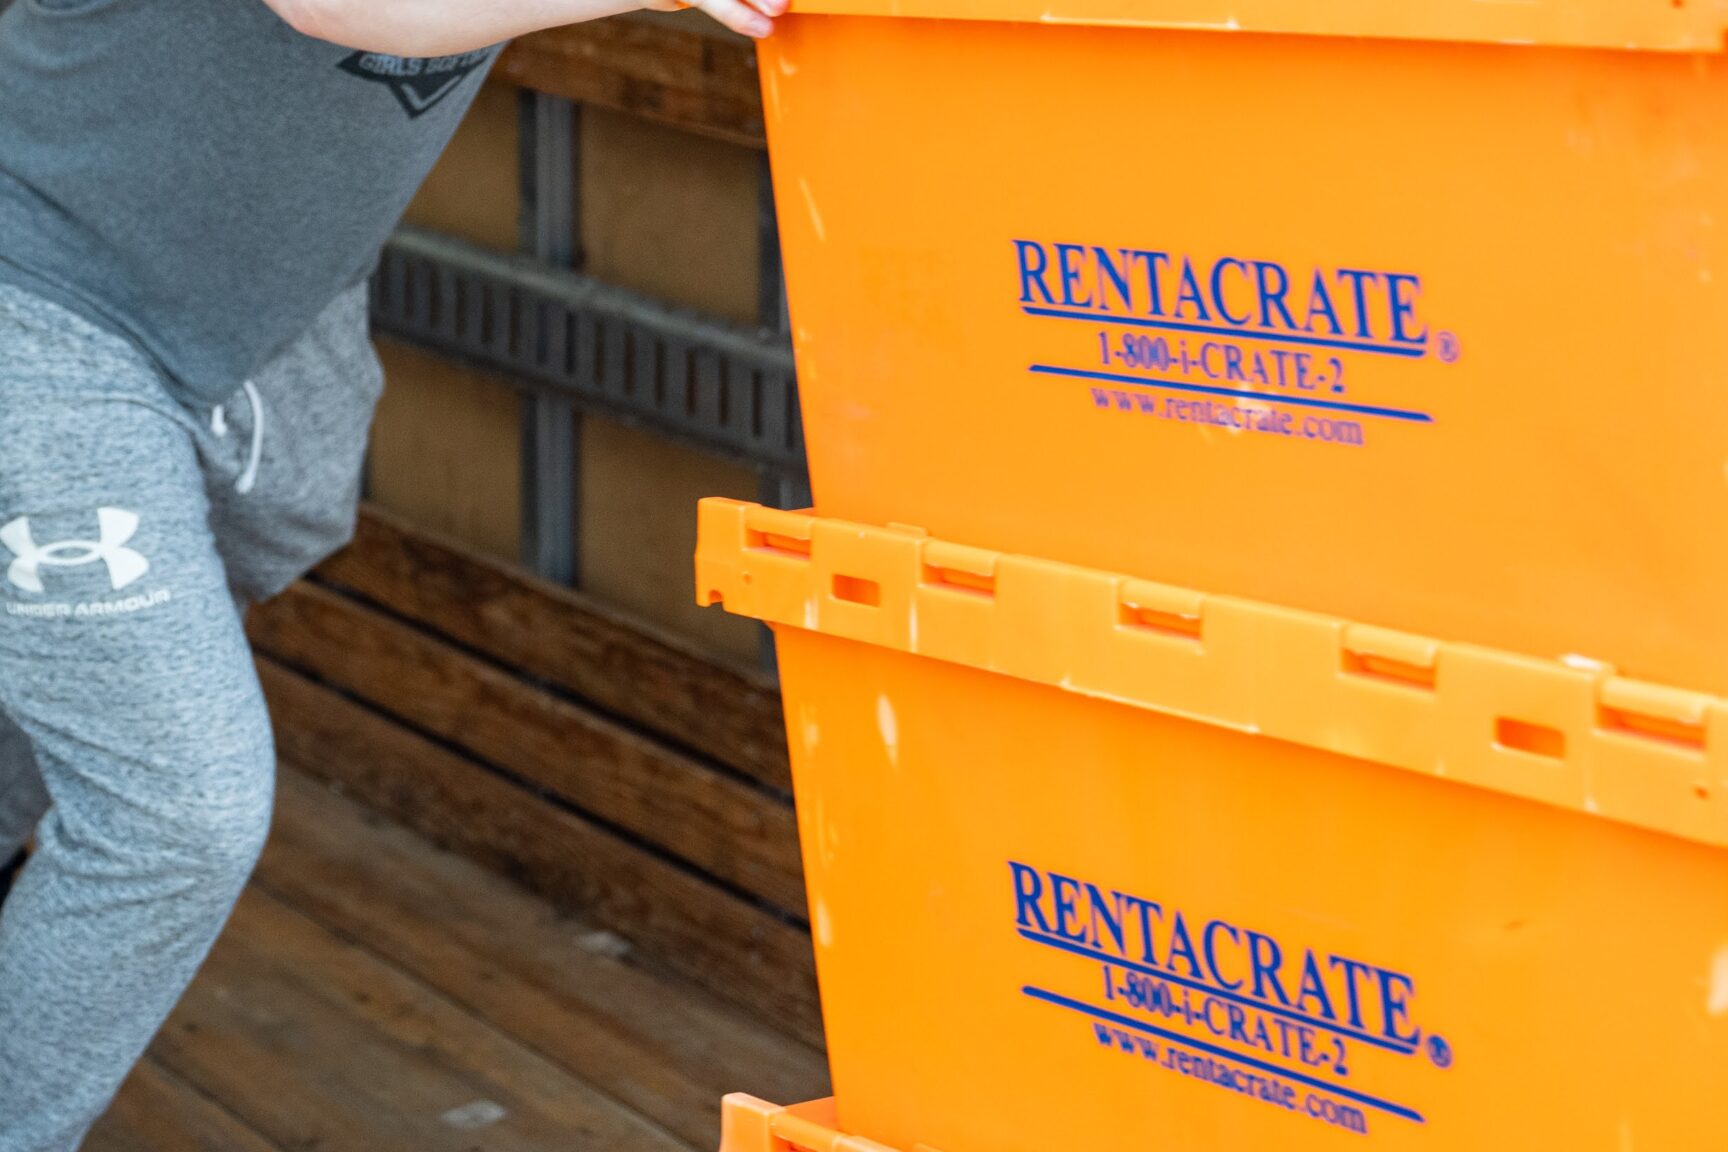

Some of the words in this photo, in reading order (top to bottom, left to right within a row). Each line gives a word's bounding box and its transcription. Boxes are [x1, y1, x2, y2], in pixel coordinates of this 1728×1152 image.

[1012, 238, 1428, 346] RENTACRATE
[1090, 386, 1366, 446] www.rentacrate.com
[1098, 330, 1347, 394] 1-800-i-CRATE-2
[5, 601, 71, 618] UNDER
[73, 588, 172, 617] ARMOUR
[1007, 860, 1421, 1046] RENTACRATE
[1102, 964, 1349, 1077] 1-800-i-CRATE-2
[1092, 1022, 1368, 1135] www.rentacrate.com
